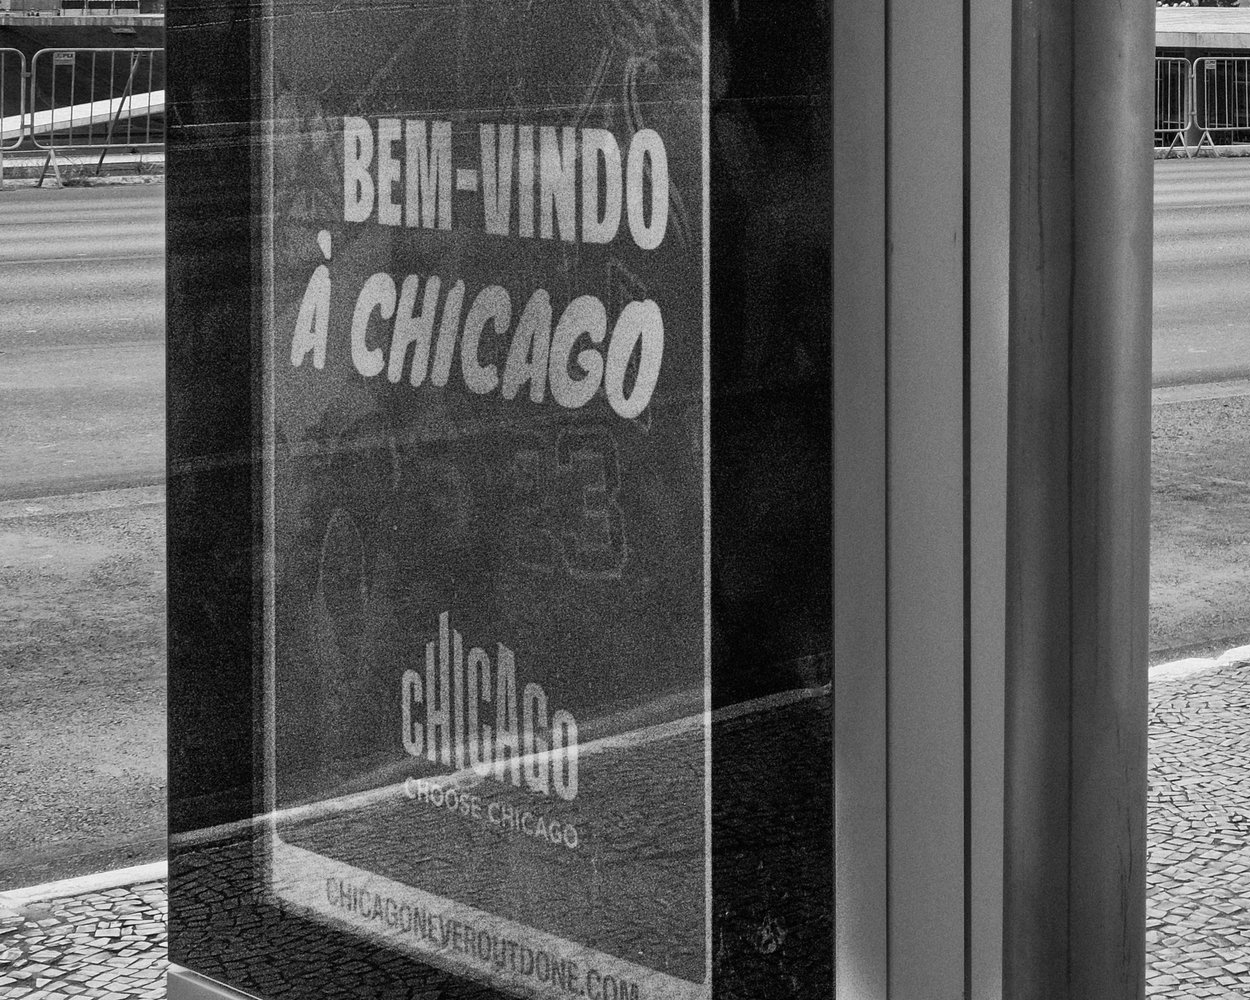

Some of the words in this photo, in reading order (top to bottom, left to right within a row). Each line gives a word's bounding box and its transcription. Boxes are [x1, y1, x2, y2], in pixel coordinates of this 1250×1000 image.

[344, 116, 669, 250] BEM-VINDO
[291, 230, 332, 369] À
[351, 273, 664, 418] CHICAGO
[402, 611, 578, 800] CHICAGO
[404, 777, 481, 820] CHOOSE
[487, 803, 578, 848] CHICAGO
